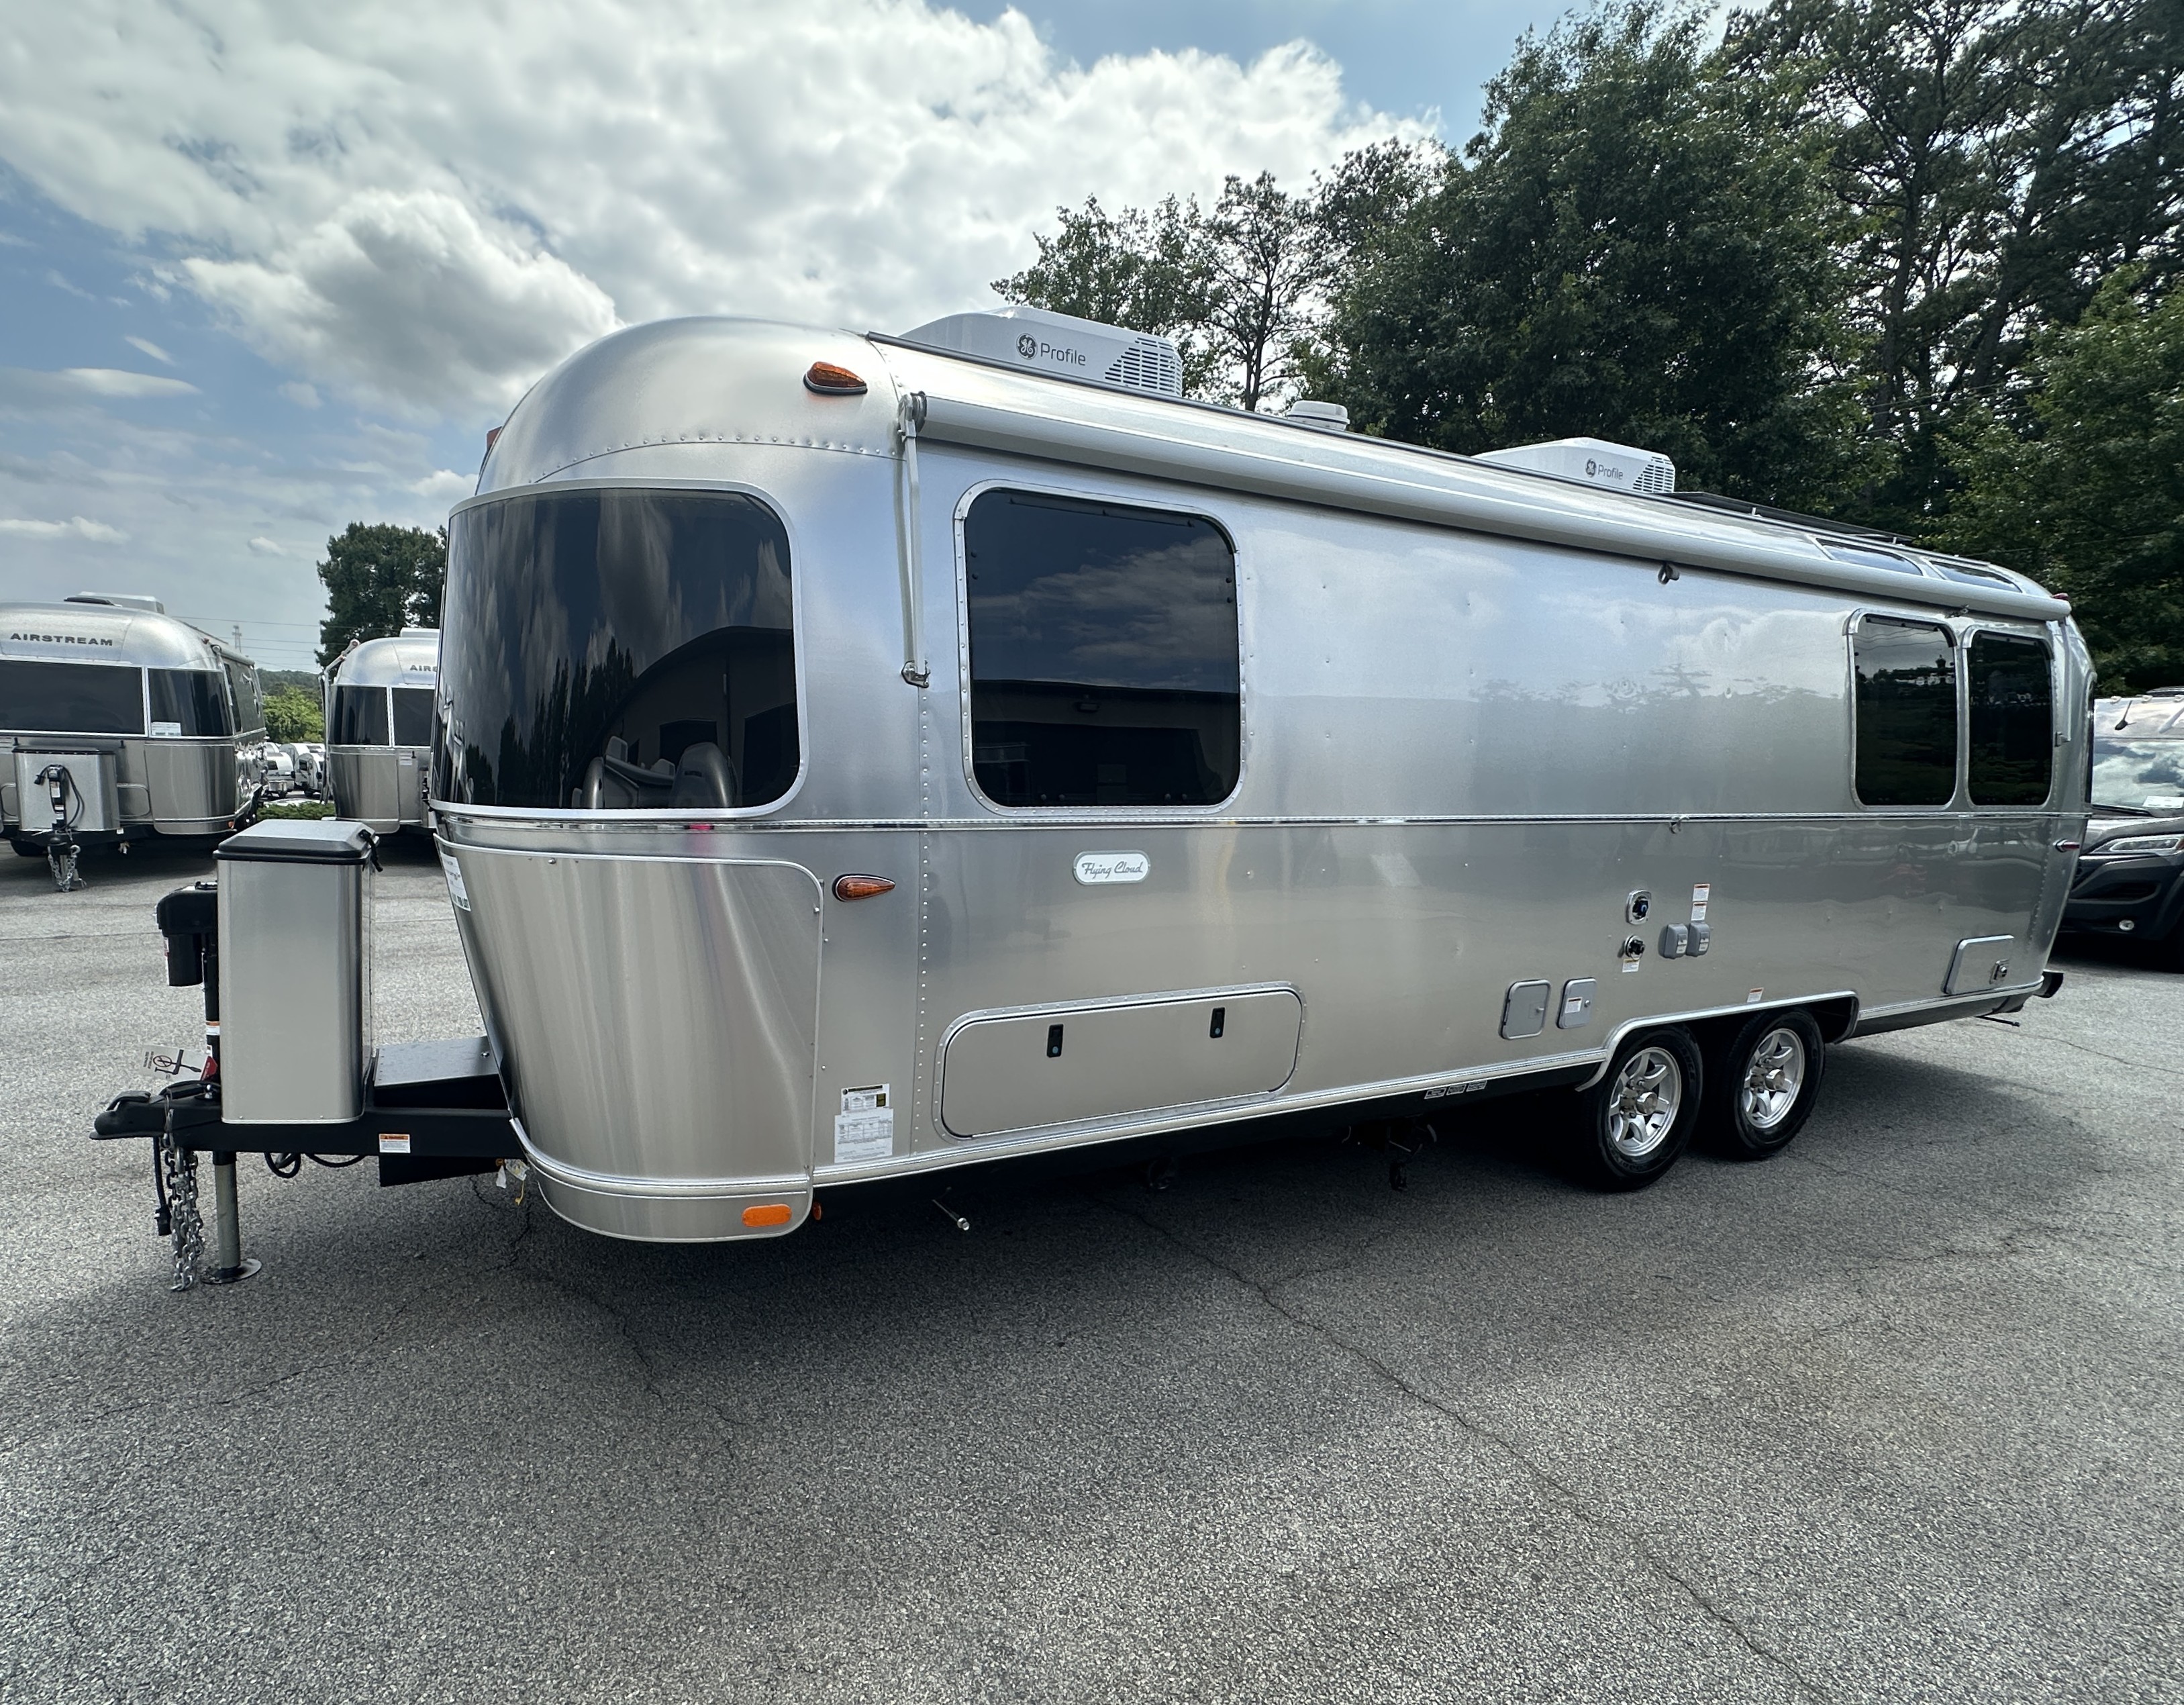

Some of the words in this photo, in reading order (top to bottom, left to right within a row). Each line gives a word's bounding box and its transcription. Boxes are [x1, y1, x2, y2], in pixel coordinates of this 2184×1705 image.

[1041, 342, 1085, 366] Profile
[1598, 465, 1623, 479] Profile
[10, 633, 113, 646] AIRSTREAM
[1082, 862, 1111, 879] Flying
[1114, 861, 1143, 873] Cloud
